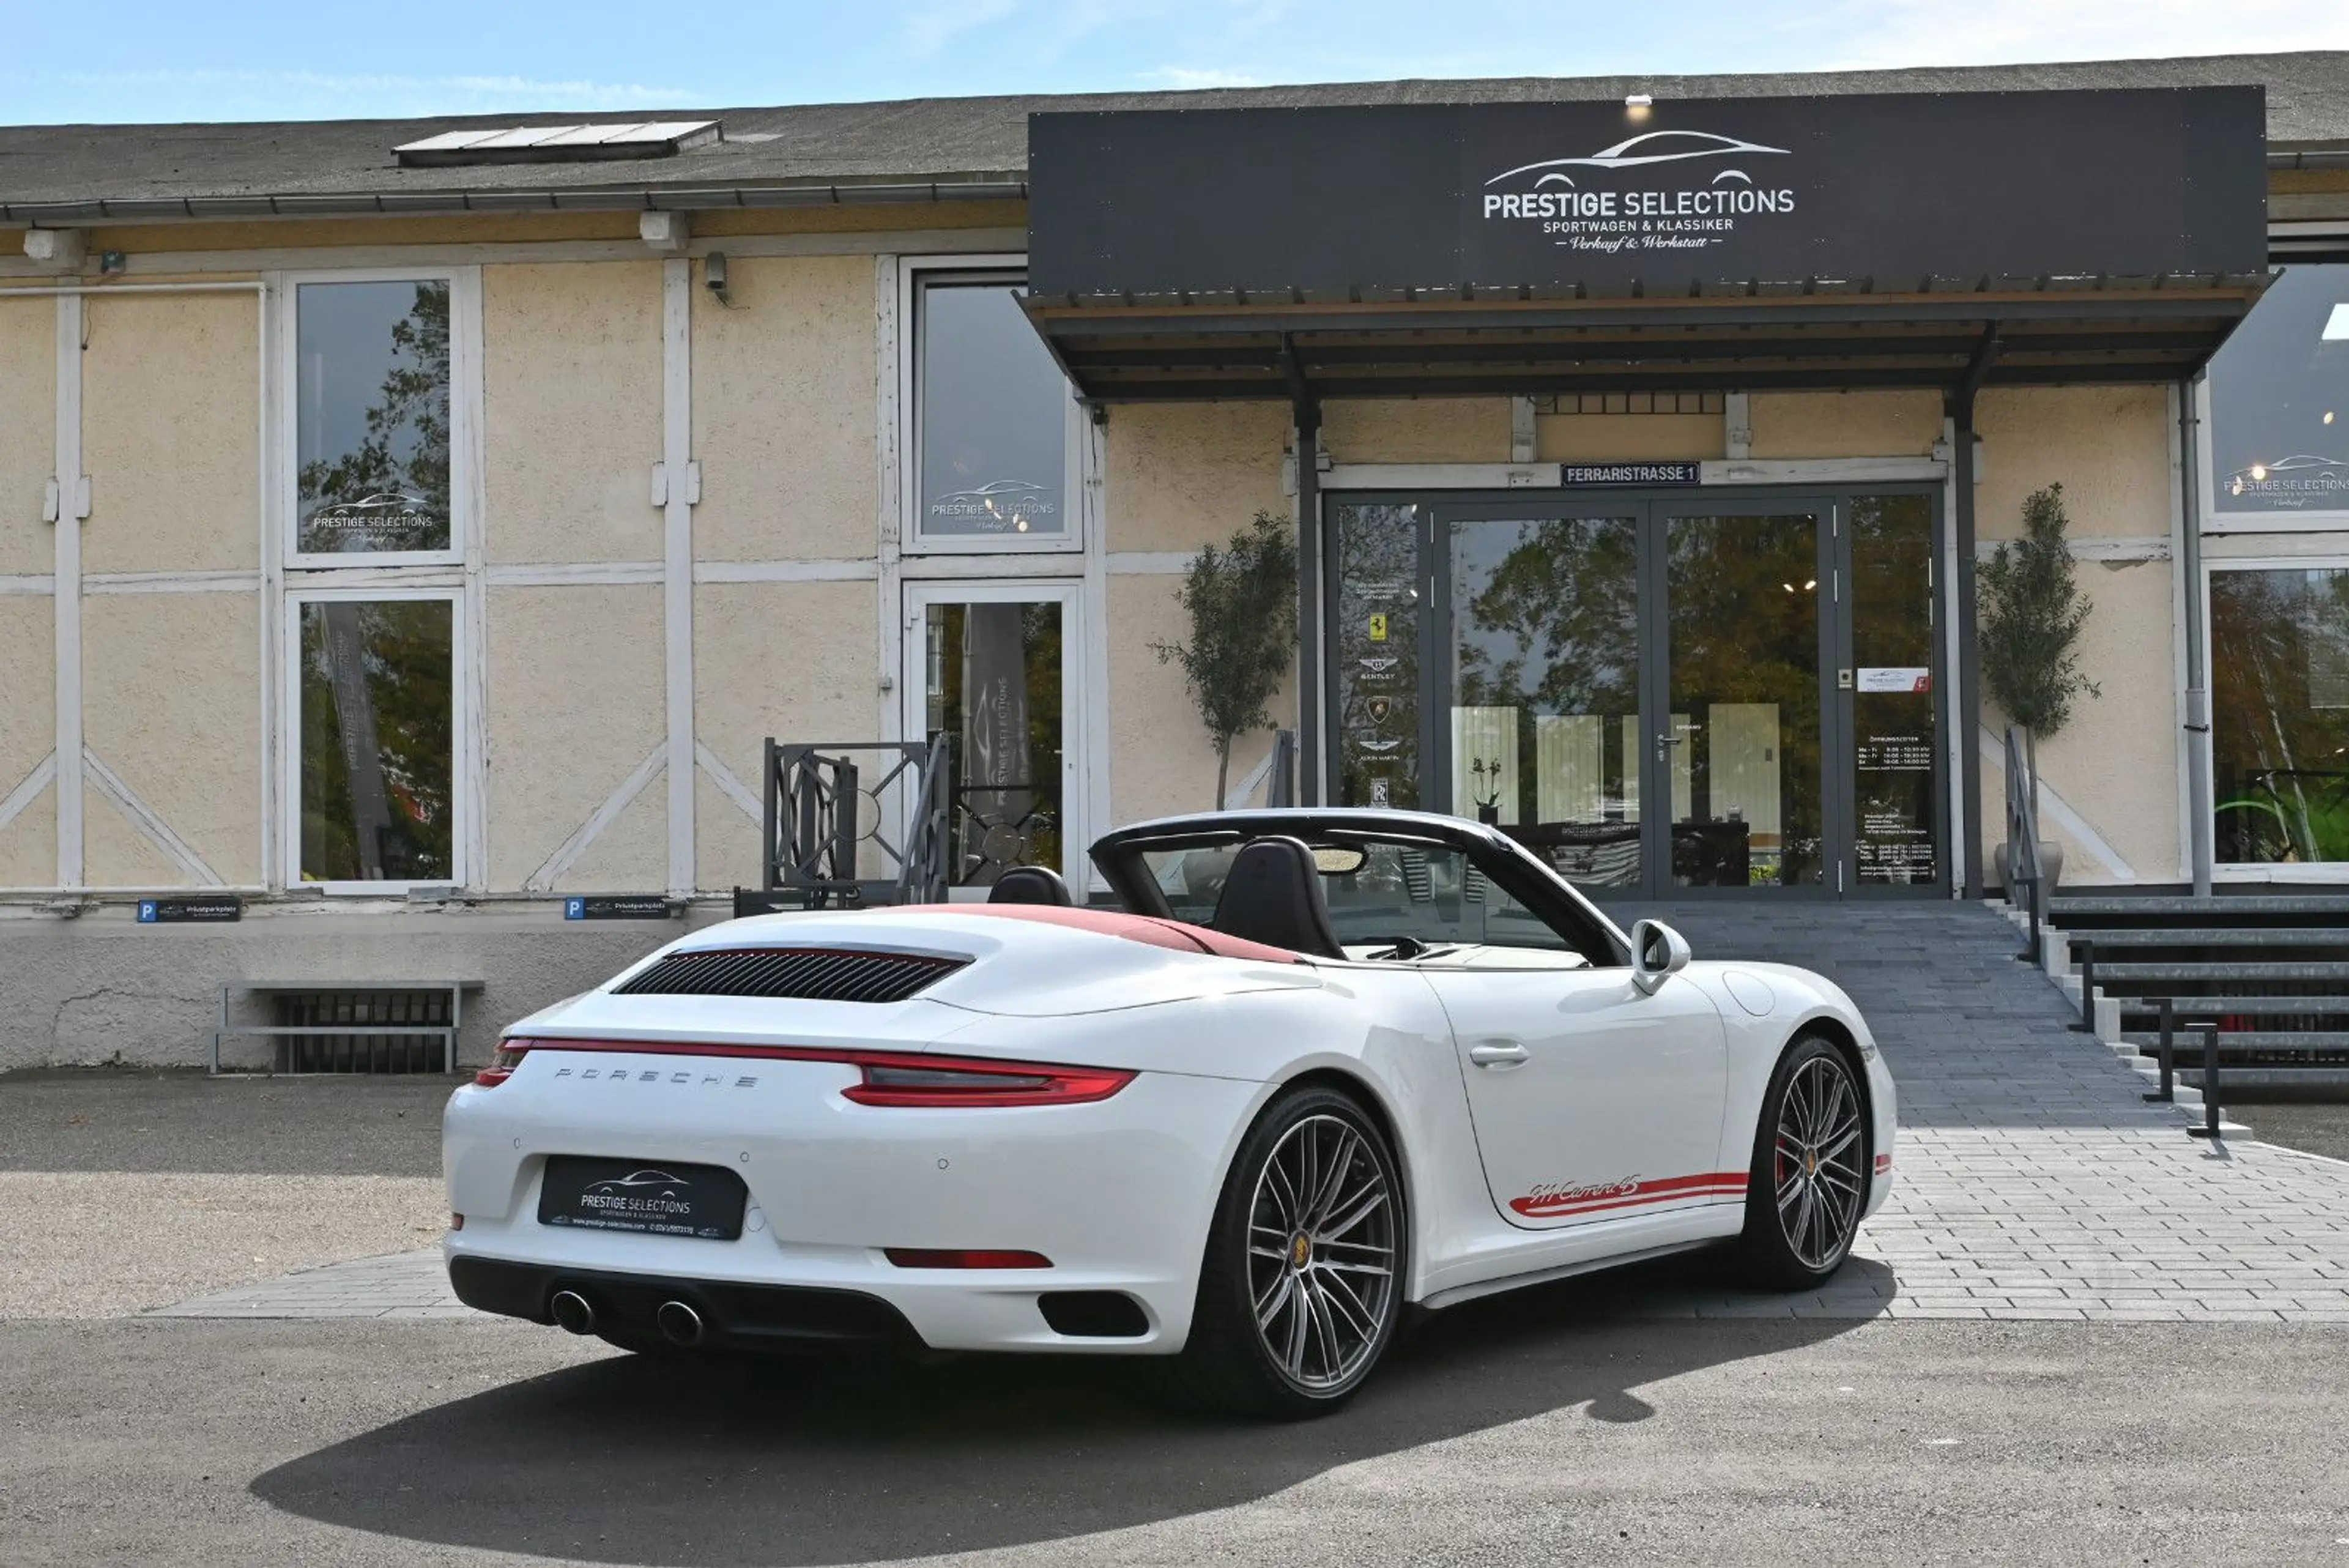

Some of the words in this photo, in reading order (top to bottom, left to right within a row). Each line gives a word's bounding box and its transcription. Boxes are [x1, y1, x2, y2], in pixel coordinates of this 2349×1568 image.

[1483, 192, 1617, 218] PRESTIGE
[1624, 189, 1795, 215] SELECTIONS
[1543, 220, 1636, 233] SPORTWAGEN
[1642, 220, 1652, 231] &
[1657, 218, 1733, 231] KLASSIKER
[1570, 236, 1625, 253] Verkauf
[1625, 239, 1639, 248] &
[1641, 235, 1707, 248] Werkstatt
[1567, 466, 1683, 481] FERRARISTRASSE
[1688, 467, 1694, 480] 1
[2223, 480, 2279, 491] PESTIGE
[932, 504, 984, 516] PRESTIGE
[313, 516, 365, 528] PRESTIGE
[367, 516, 432, 527] SELECTIONS
[142, 904, 153, 919] P
[570, 901, 581, 915] P
[555, 1068, 759, 1088] PORSCHE
[1530, 1183, 1557, 1204] 911
[1559, 1180, 1618, 1200] Carrera
[581, 1194, 626, 1209] PRESTIGE
[628, 1197, 691, 1214] SELECTIONS
